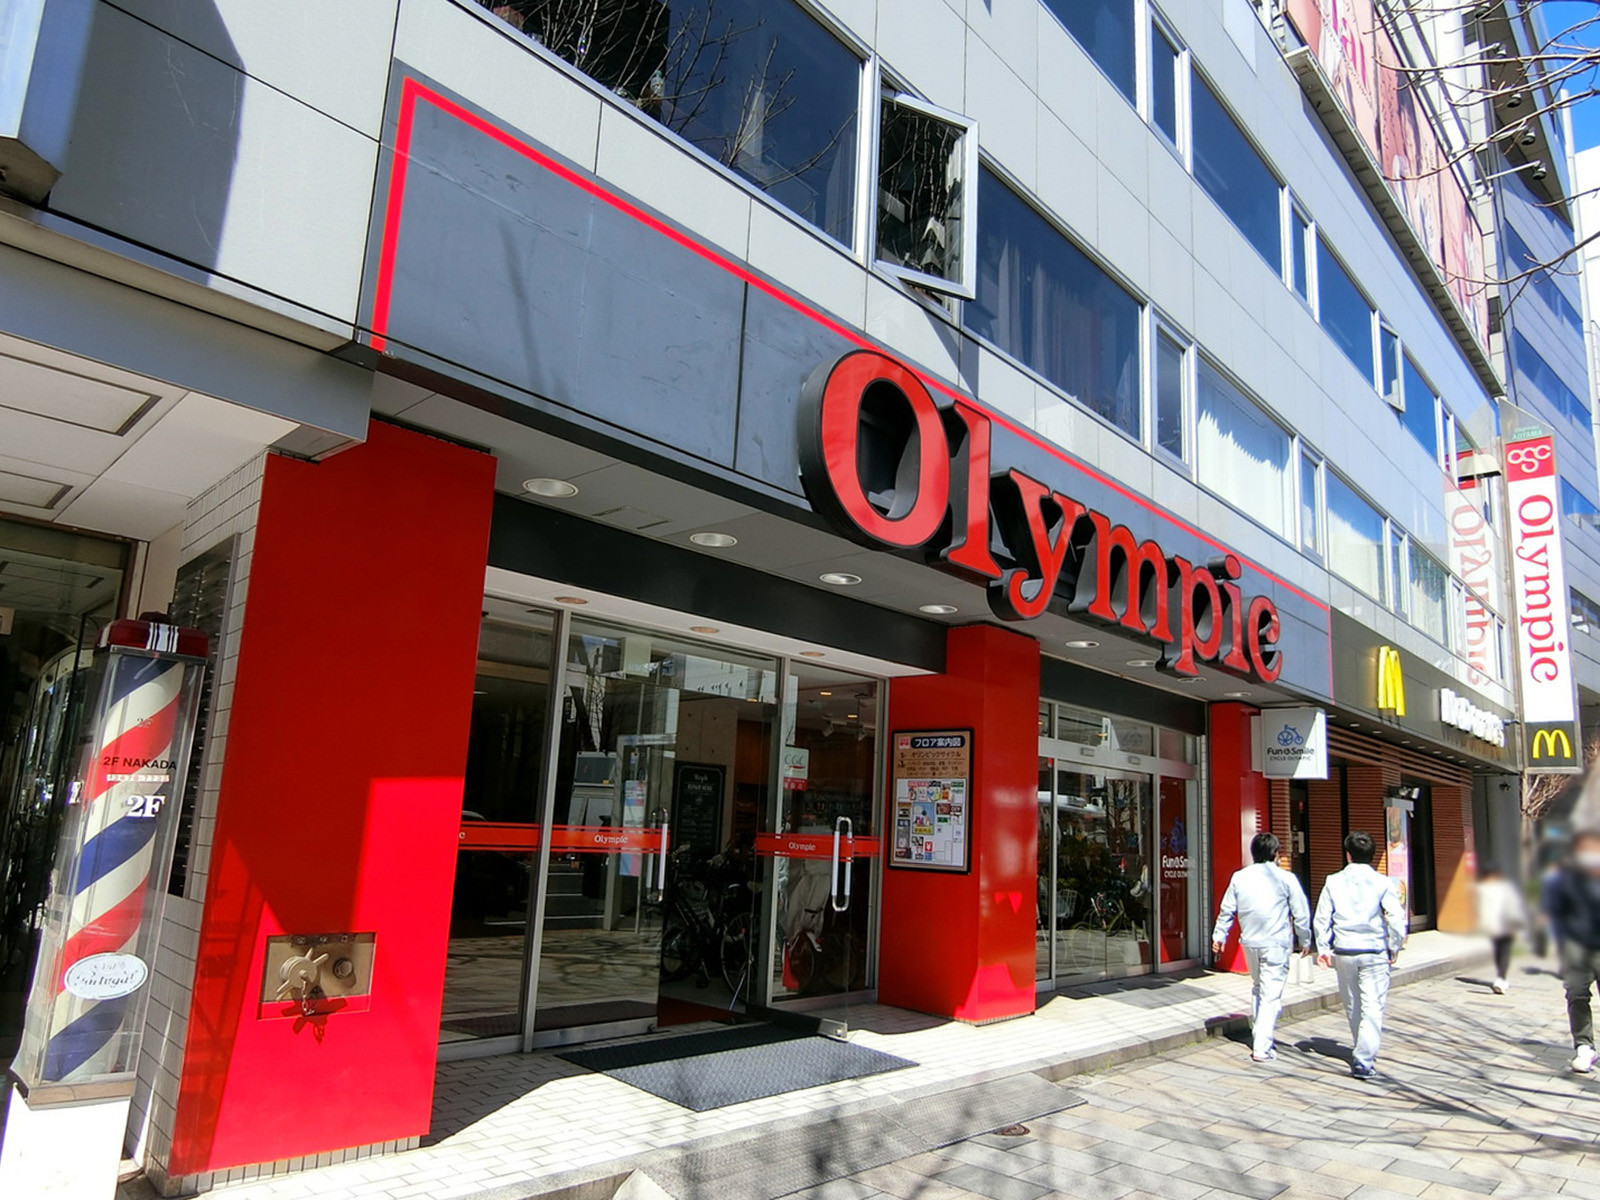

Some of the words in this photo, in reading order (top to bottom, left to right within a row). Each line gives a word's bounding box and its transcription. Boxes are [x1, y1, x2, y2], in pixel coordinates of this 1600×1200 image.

[800, 348, 1284, 683] Olympic
[1516, 494, 1564, 684] Olympic
[914, 737, 962, 748] フロア案内図
[103, 756, 120, 767] 2F
[123, 758, 177, 770] NAKADA
[126, 794, 166, 818] 2F
[594, 834, 629, 845] Olympic
[788, 841, 817, 852] Olympic
